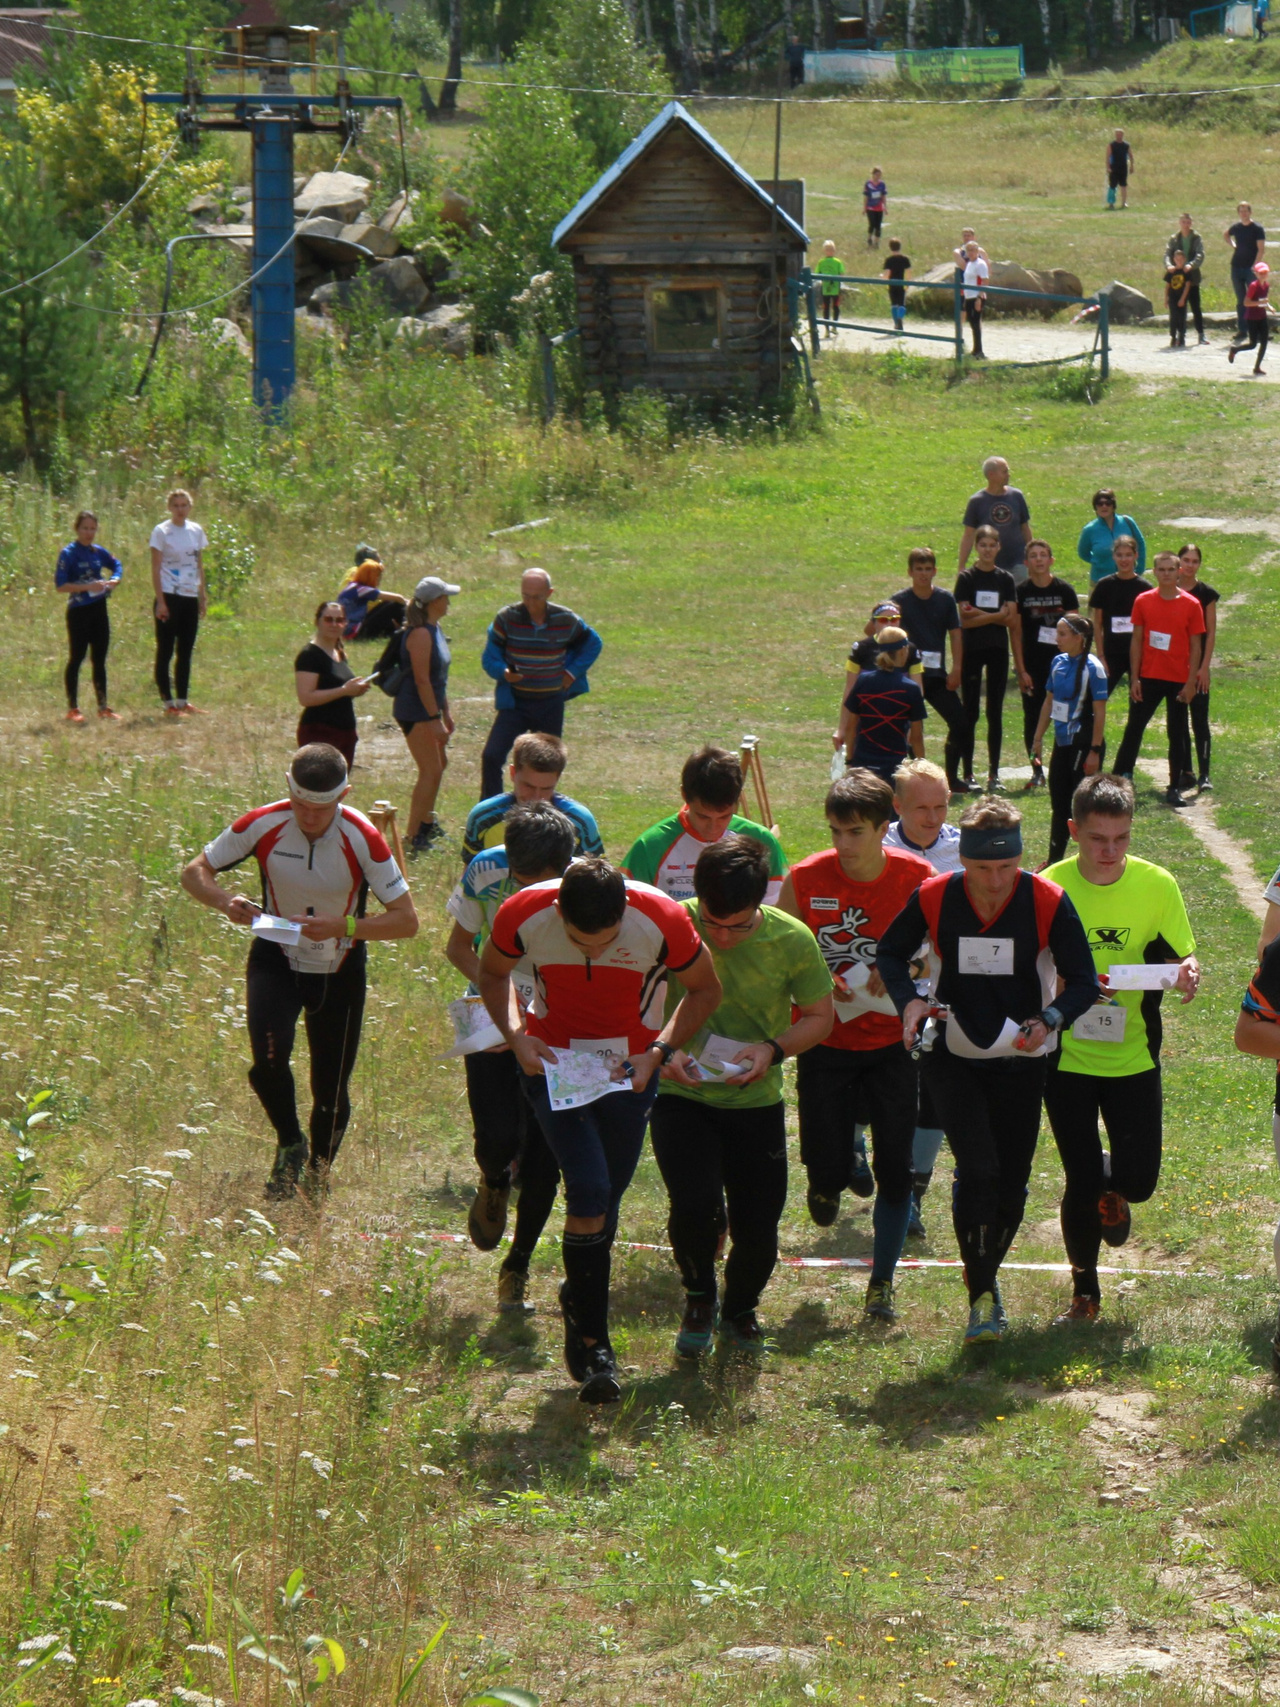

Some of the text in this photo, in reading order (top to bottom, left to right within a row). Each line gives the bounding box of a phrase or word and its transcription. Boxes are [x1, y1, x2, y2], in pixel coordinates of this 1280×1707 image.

[311, 943, 325, 951] 30
[992, 945, 1000, 956] 7
[519, 984, 532, 997] 19
[1098, 1016, 1112, 1026] 15
